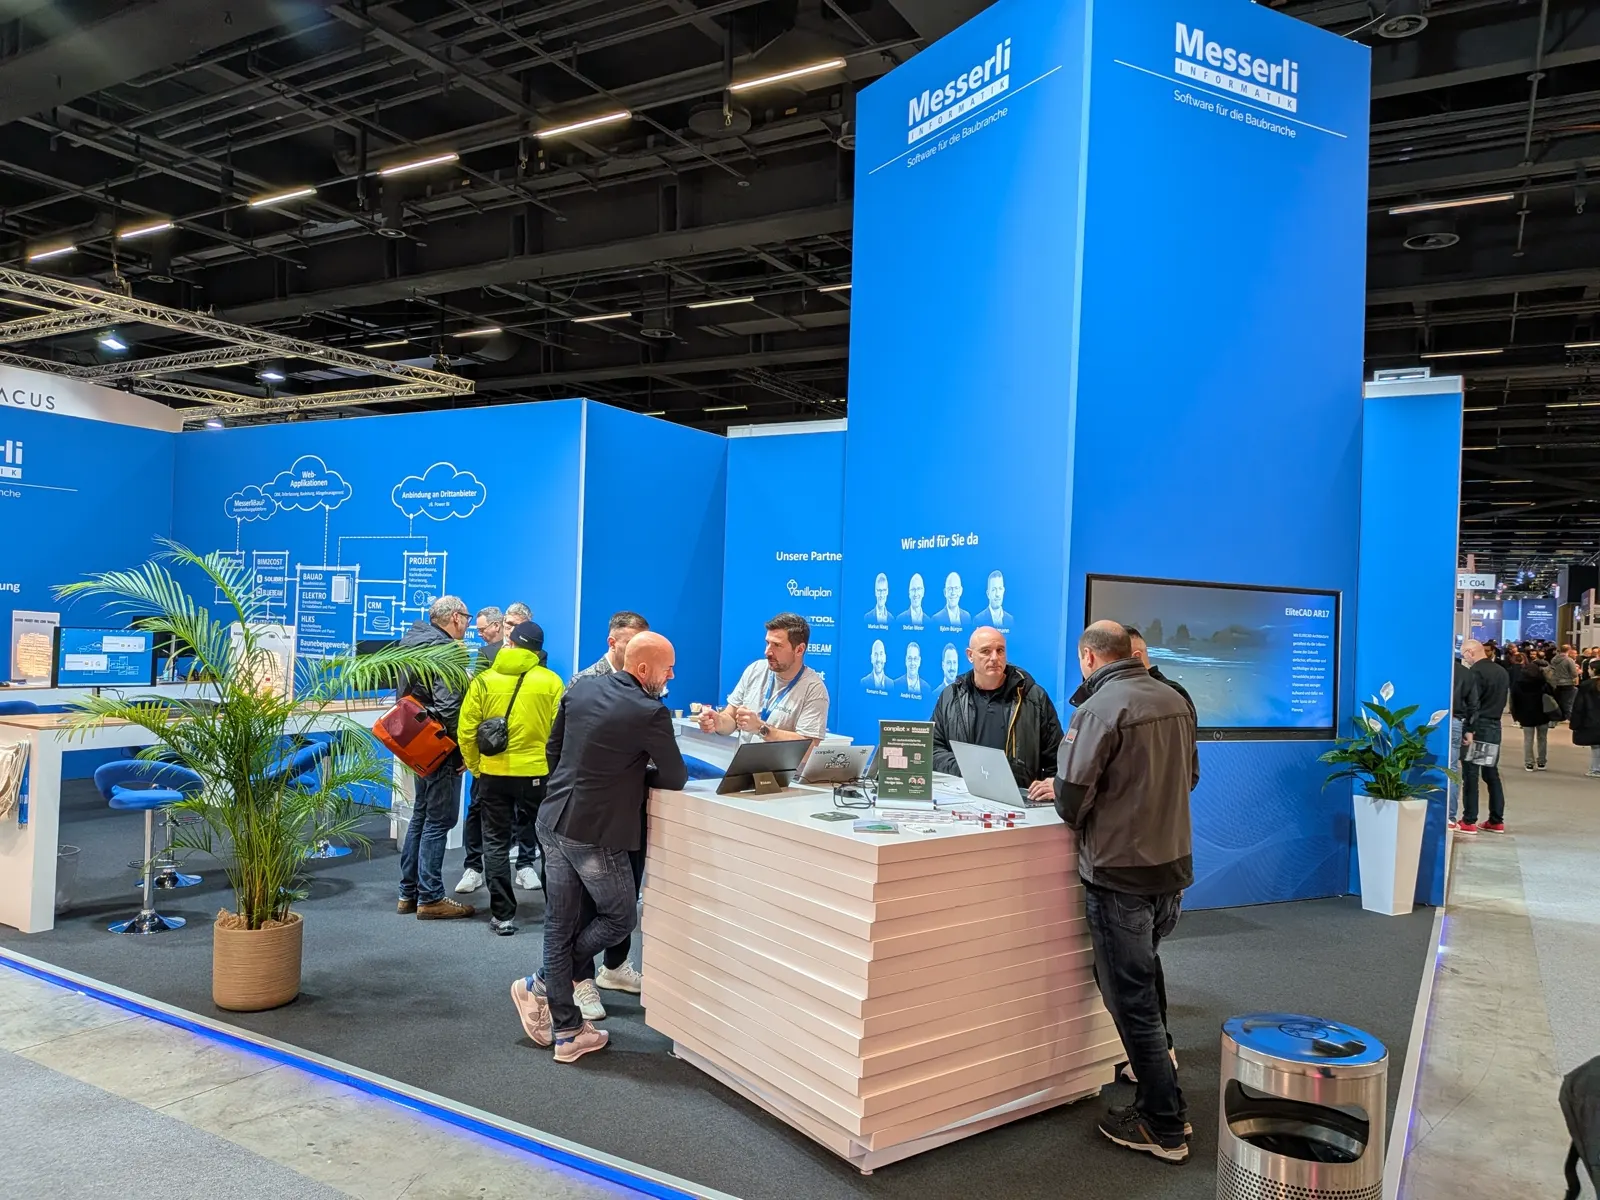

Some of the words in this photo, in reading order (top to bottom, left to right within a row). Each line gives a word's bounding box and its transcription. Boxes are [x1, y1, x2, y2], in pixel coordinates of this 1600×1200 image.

[1175, 22, 1298, 94] Messerli
[908, 37, 1011, 127] Messerli
[1180, 62, 1293, 109] INFORMATIK
[911, 79, 1005, 141] INFORMATIK
[1173, 89, 1214, 112] Software
[1216, 103, 1228, 117] für
[1230, 109, 1244, 122] die
[1246, 113, 1296, 139] Baubranche
[906, 145, 937, 168] Software
[938, 140, 948, 152] für
[949, 134, 960, 146] die
[962, 107, 1008, 139] Baubranche
[290, 480, 328, 488] Applikationen
[402, 491, 431, 499] Anbindung
[776, 552, 808, 561] Unsere
[811, 552, 842, 561] Partne
[901, 538, 916, 550] Wir
[917, 536, 935, 548] sind
[936, 535, 950, 548] für
[952, 534, 964, 546] Sie
[966, 532, 978, 545] da
[1285, 608, 1312, 617] EliteCAD
